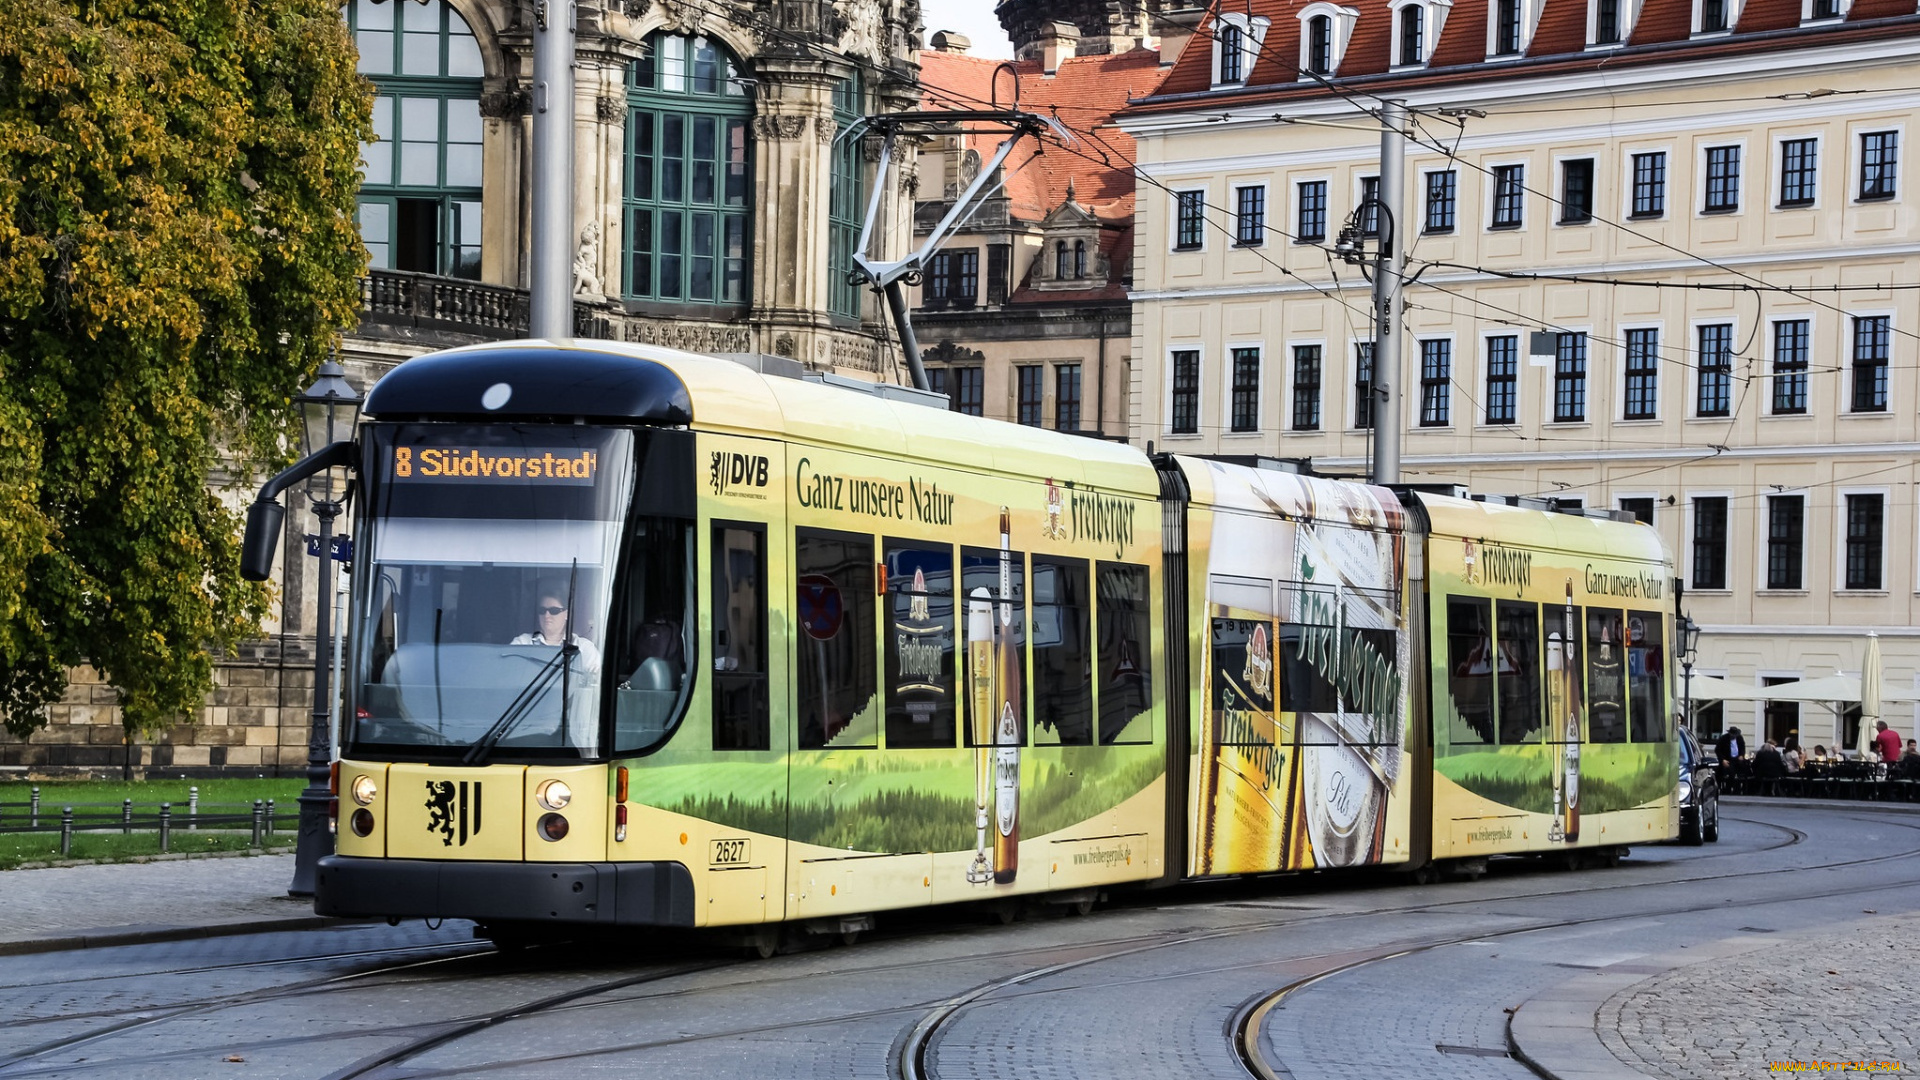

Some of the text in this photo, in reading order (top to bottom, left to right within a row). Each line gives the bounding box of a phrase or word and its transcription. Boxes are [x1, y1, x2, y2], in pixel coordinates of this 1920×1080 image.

[396, 446, 412, 477] 8
[731, 452, 769, 487] DVB
[796, 457, 955, 526] Ganz unsere Natur
[1064, 480, 1135, 560] Freiberger
[1476, 536, 1532, 598] Freiberger
[1585, 563, 1609, 595] Ganz
[1610, 574, 1637, 598] unsere
[1639, 569, 1663, 600] Natur
[1222, 687, 1287, 790] Freiberger
[1326, 770, 1352, 817] Pils
[715, 841, 745, 862] 2627
